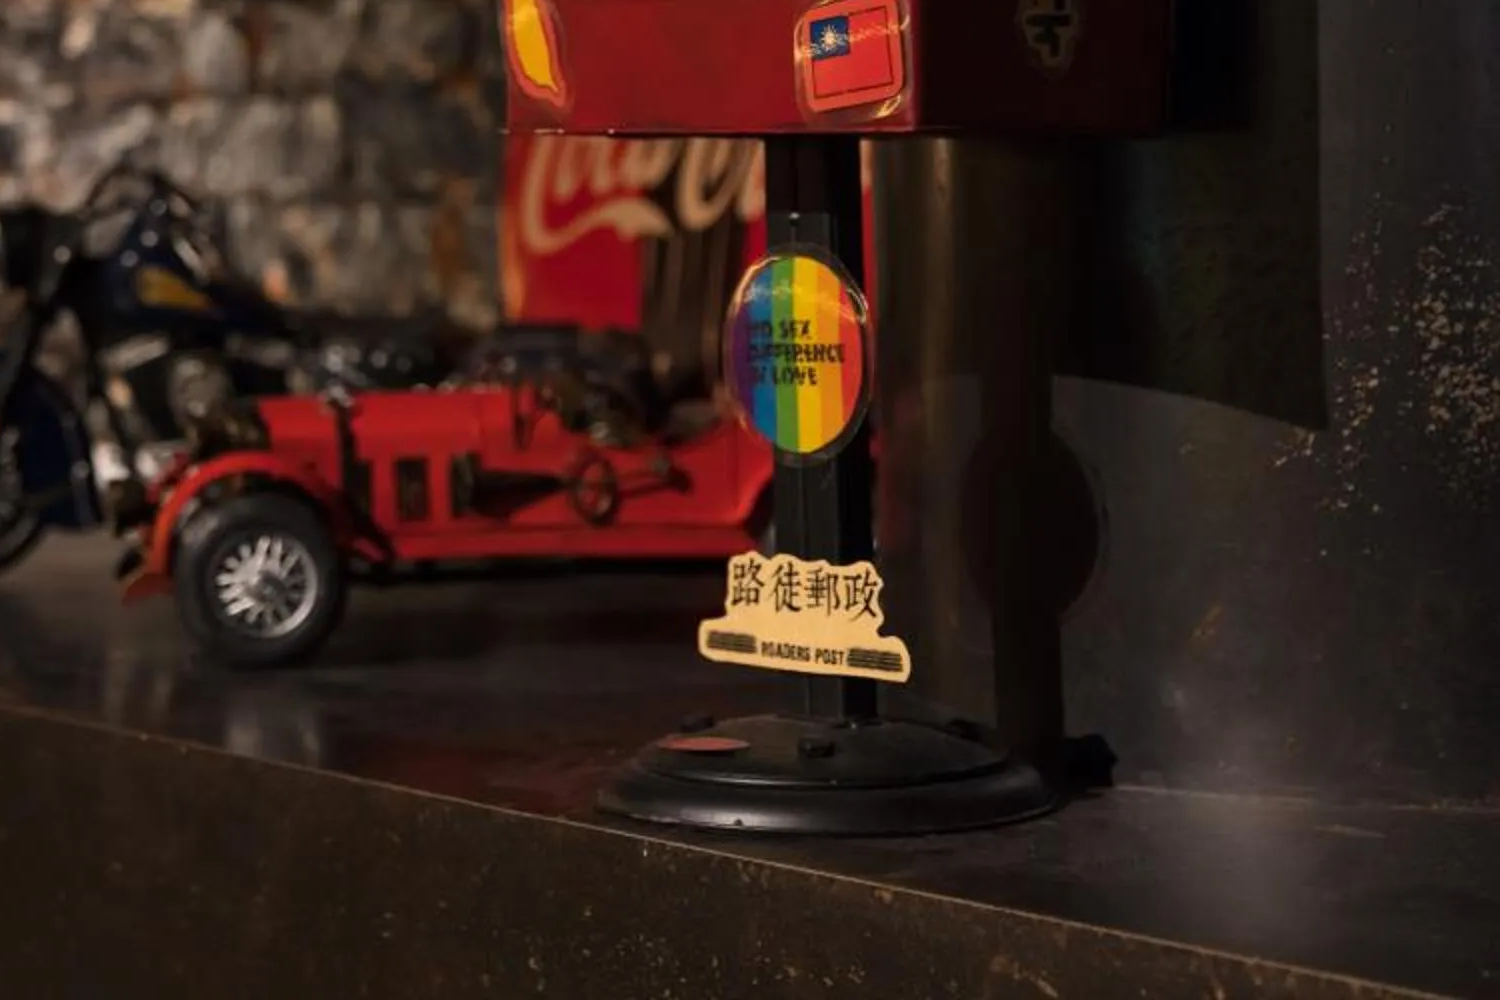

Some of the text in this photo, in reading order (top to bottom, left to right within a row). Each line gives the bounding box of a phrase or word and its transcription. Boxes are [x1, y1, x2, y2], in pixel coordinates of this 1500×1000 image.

[779, 318, 812, 339] SEX
[773, 365, 819, 386] LOVE
[731, 557, 880, 622] 路徒郵政
[761, 640, 845, 666] ROADERS POST
